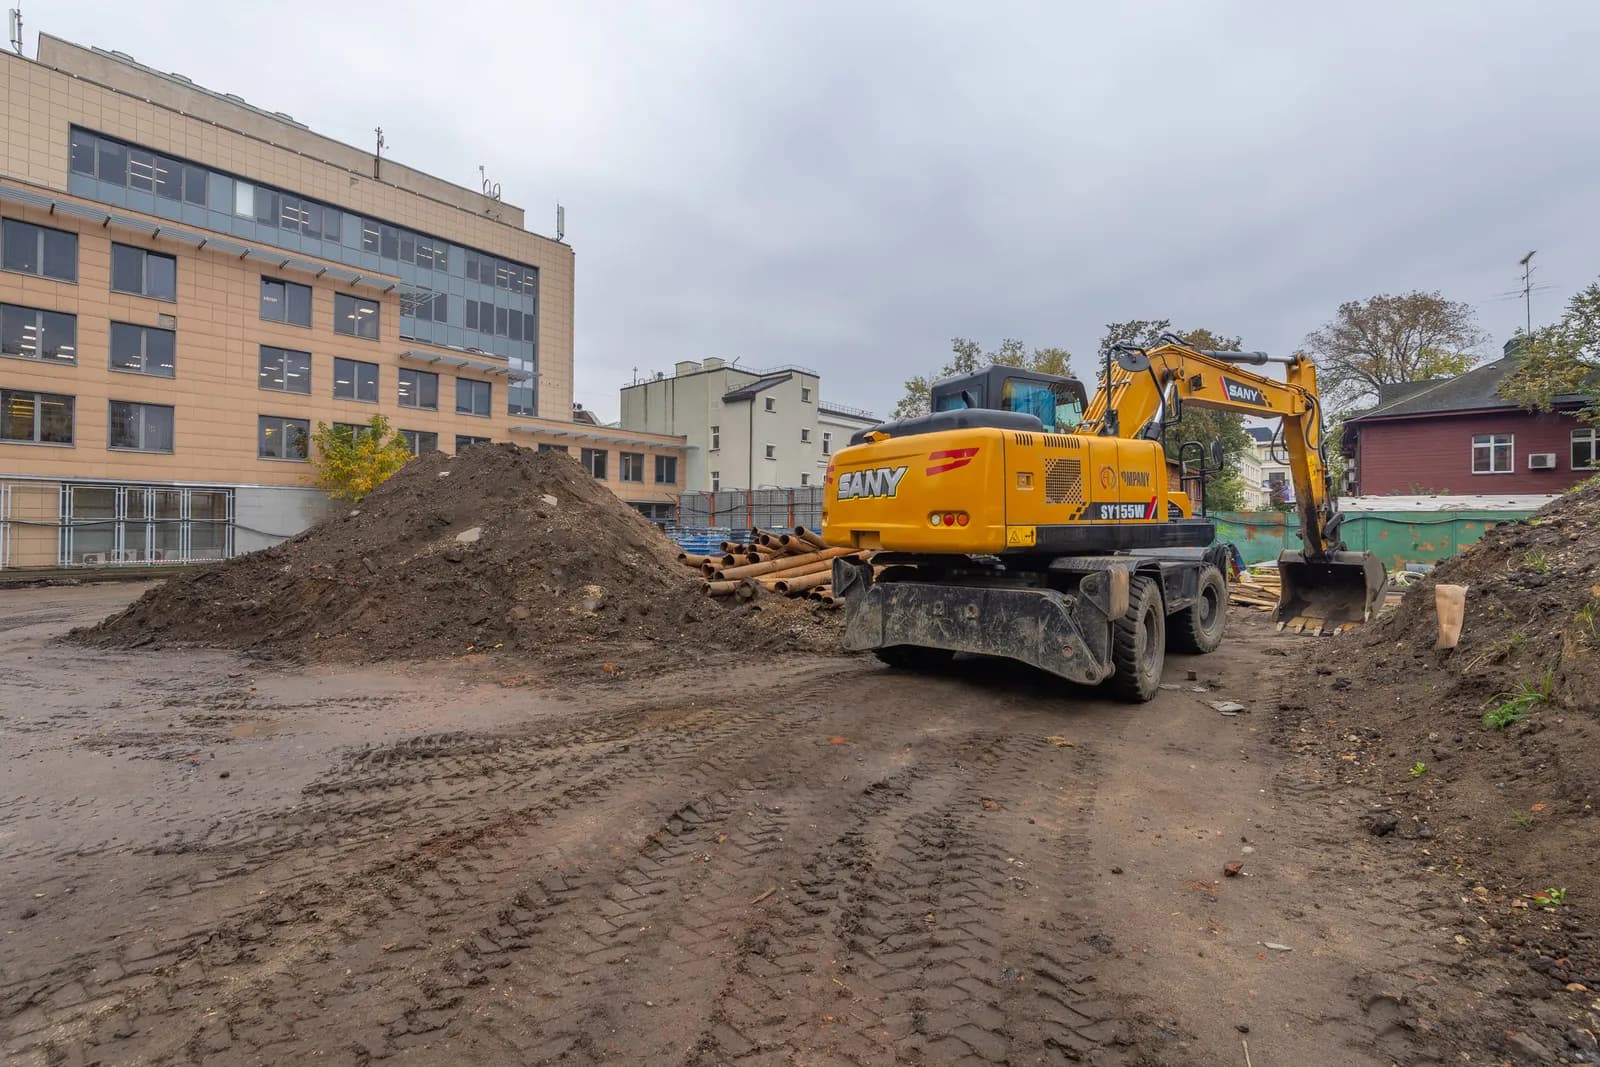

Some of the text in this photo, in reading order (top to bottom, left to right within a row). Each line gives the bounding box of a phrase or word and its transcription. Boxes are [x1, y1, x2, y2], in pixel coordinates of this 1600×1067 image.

[1229, 385, 1258, 401] SANY
[837, 466, 908, 500] SANY
[1100, 504, 1145, 519] SY155W
